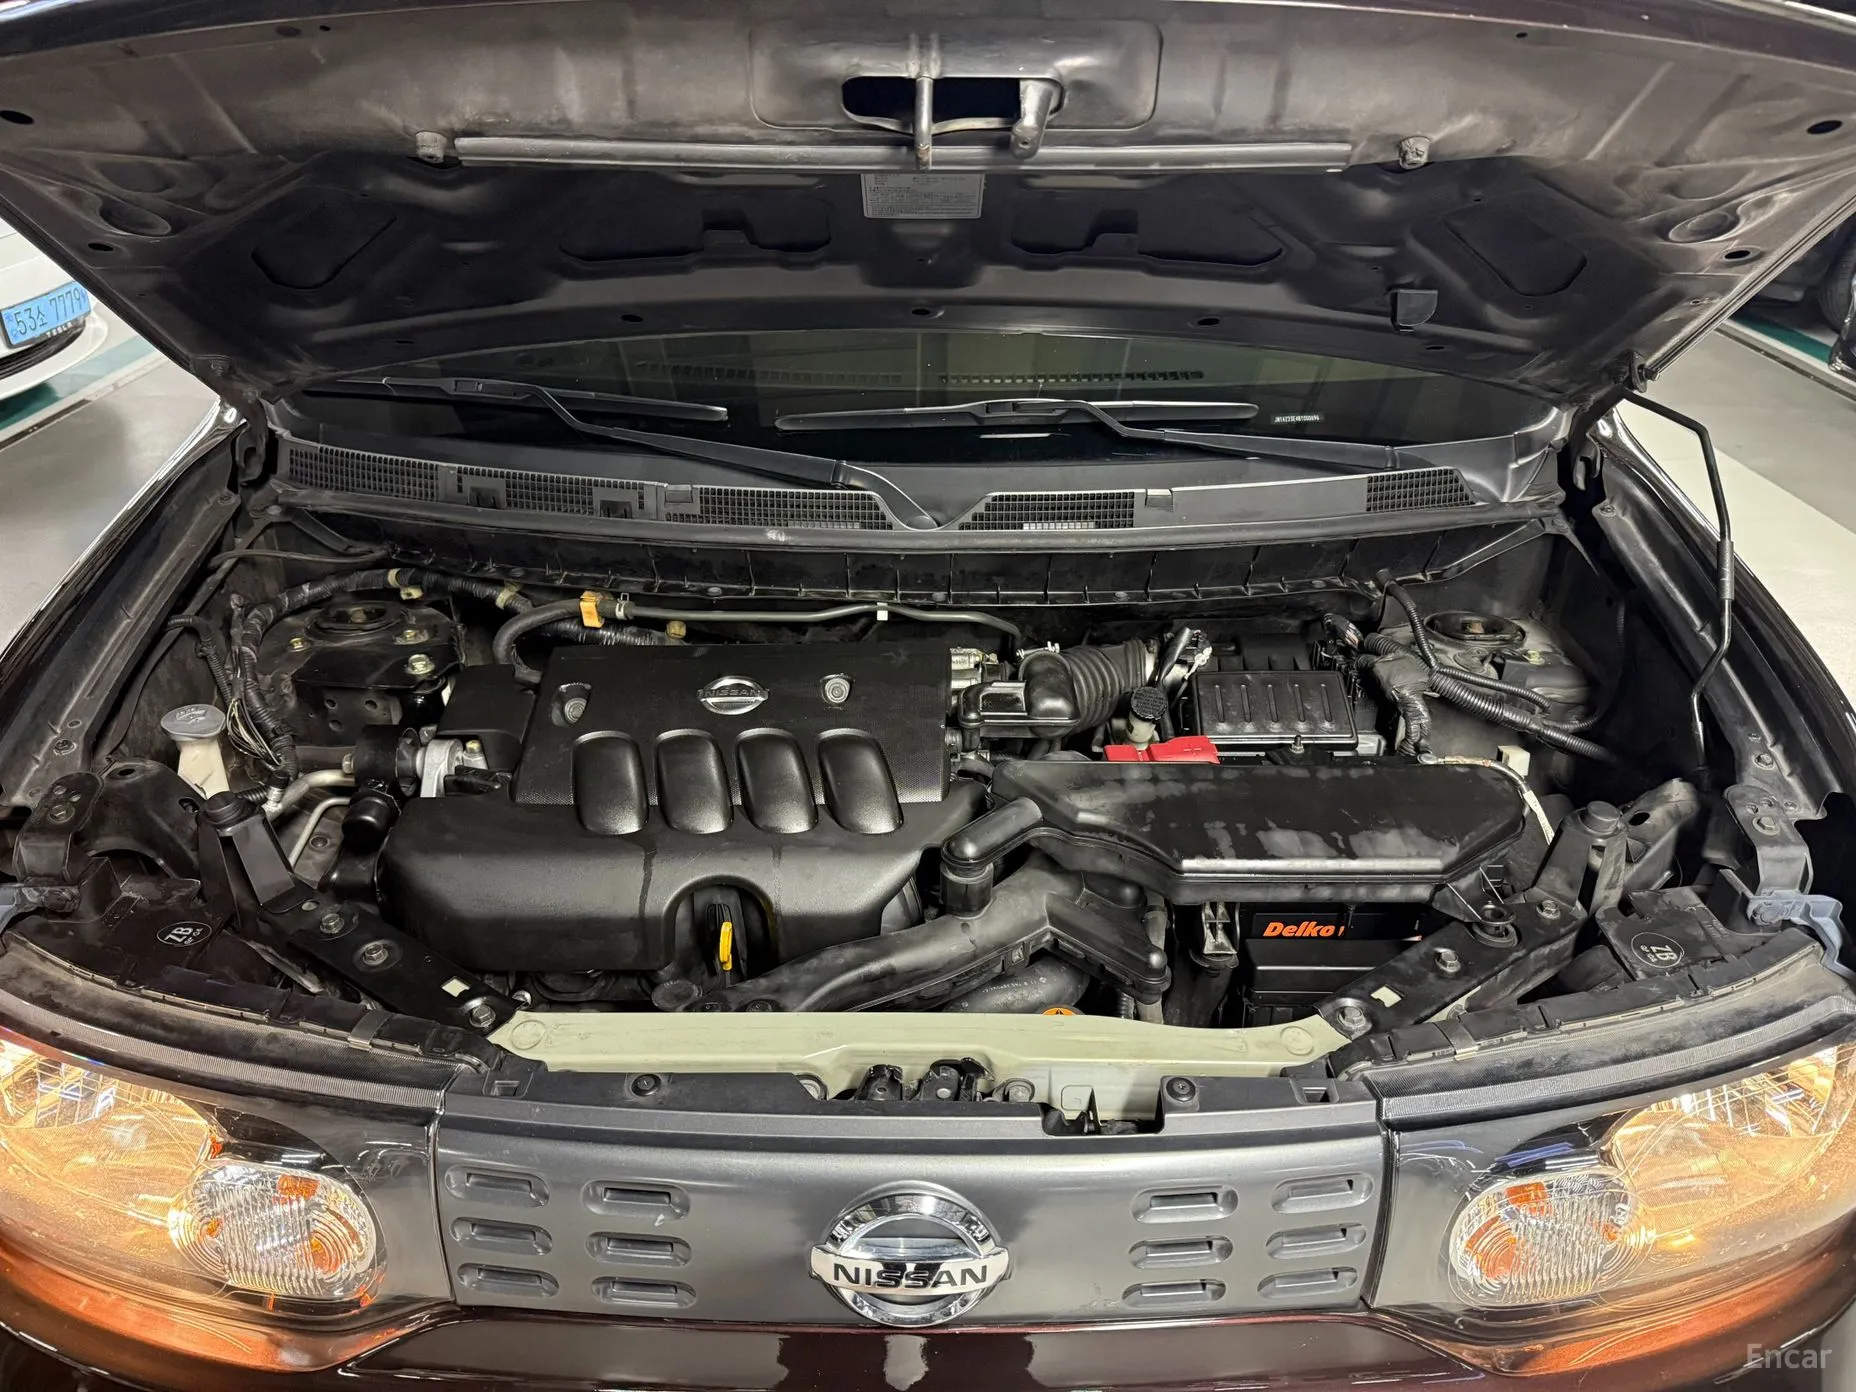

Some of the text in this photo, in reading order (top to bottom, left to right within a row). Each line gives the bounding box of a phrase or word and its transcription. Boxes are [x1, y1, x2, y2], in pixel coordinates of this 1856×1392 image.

[14, 287, 82, 336] 53소 7779
[45, 321, 74, 338] TESLA
[704, 687, 762, 698] NISSAN
[164, 926, 194, 943] ZB
[1262, 921, 1335, 937] Delko
[1650, 945, 1678, 960] ZB
[832, 1262, 988, 1289] NISSAN
